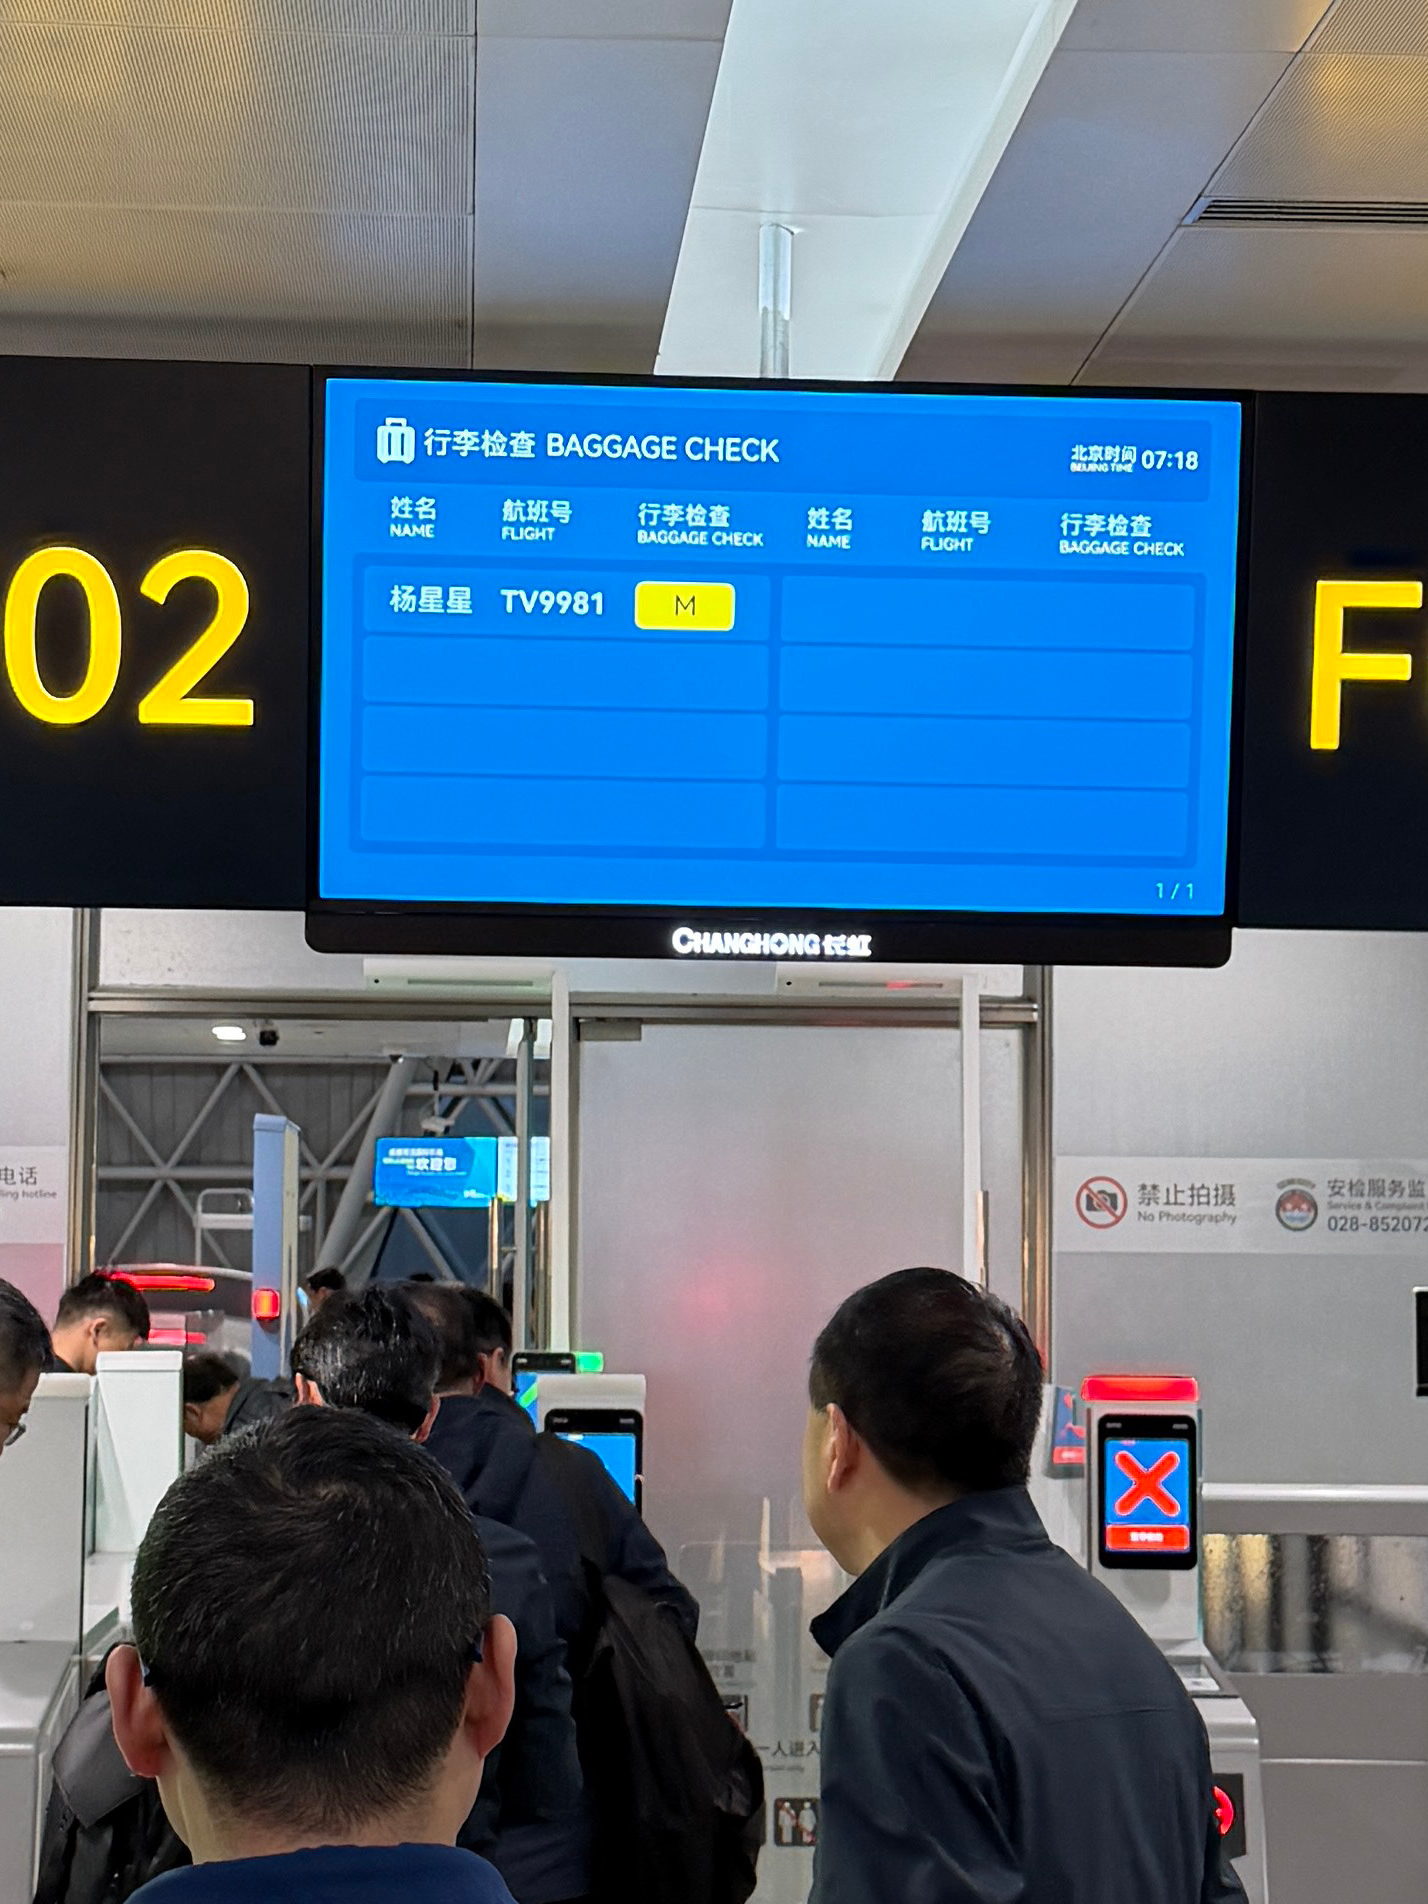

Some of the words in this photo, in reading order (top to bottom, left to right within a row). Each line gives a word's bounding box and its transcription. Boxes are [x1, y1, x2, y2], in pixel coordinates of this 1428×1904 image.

[423, 427, 537, 459] 行李检查
[546, 432, 678, 461] BAGGAGE
[684, 436, 780, 463] CHECK
[1071, 444, 1137, 464] 北京时间
[1141, 449, 1199, 471] 07:18
[390, 496, 437, 521] 姓名
[502, 499, 573, 524] 航班号
[638, 502, 730, 528] 行李检查
[807, 507, 853, 531] 姓名
[390, 523, 435, 538] NAME
[502, 527, 556, 542] FLIGHT
[921, 510, 991, 535] 航班号
[1060, 513, 1152, 538] 行李检查
[637, 529, 708, 546] BAGGAGE
[712, 531, 764, 547] CHECK
[806, 534, 851, 549] NAME
[921, 537, 974, 552] FLIGHT
[1059, 540, 1130, 556] BAGGAGE
[1133, 541, 1185, 557] CHECK
[389, 584, 474, 615] 杨星星
[500, 588, 605, 616] TV9981
[674, 595, 697, 616] M
[671, 926, 821, 956] CHANGHONG
[1137, 1182, 1236, 1207] 禁止拍摄
[1137, 1210, 1155, 1222] No
[1158, 1210, 1238, 1226] Photography
